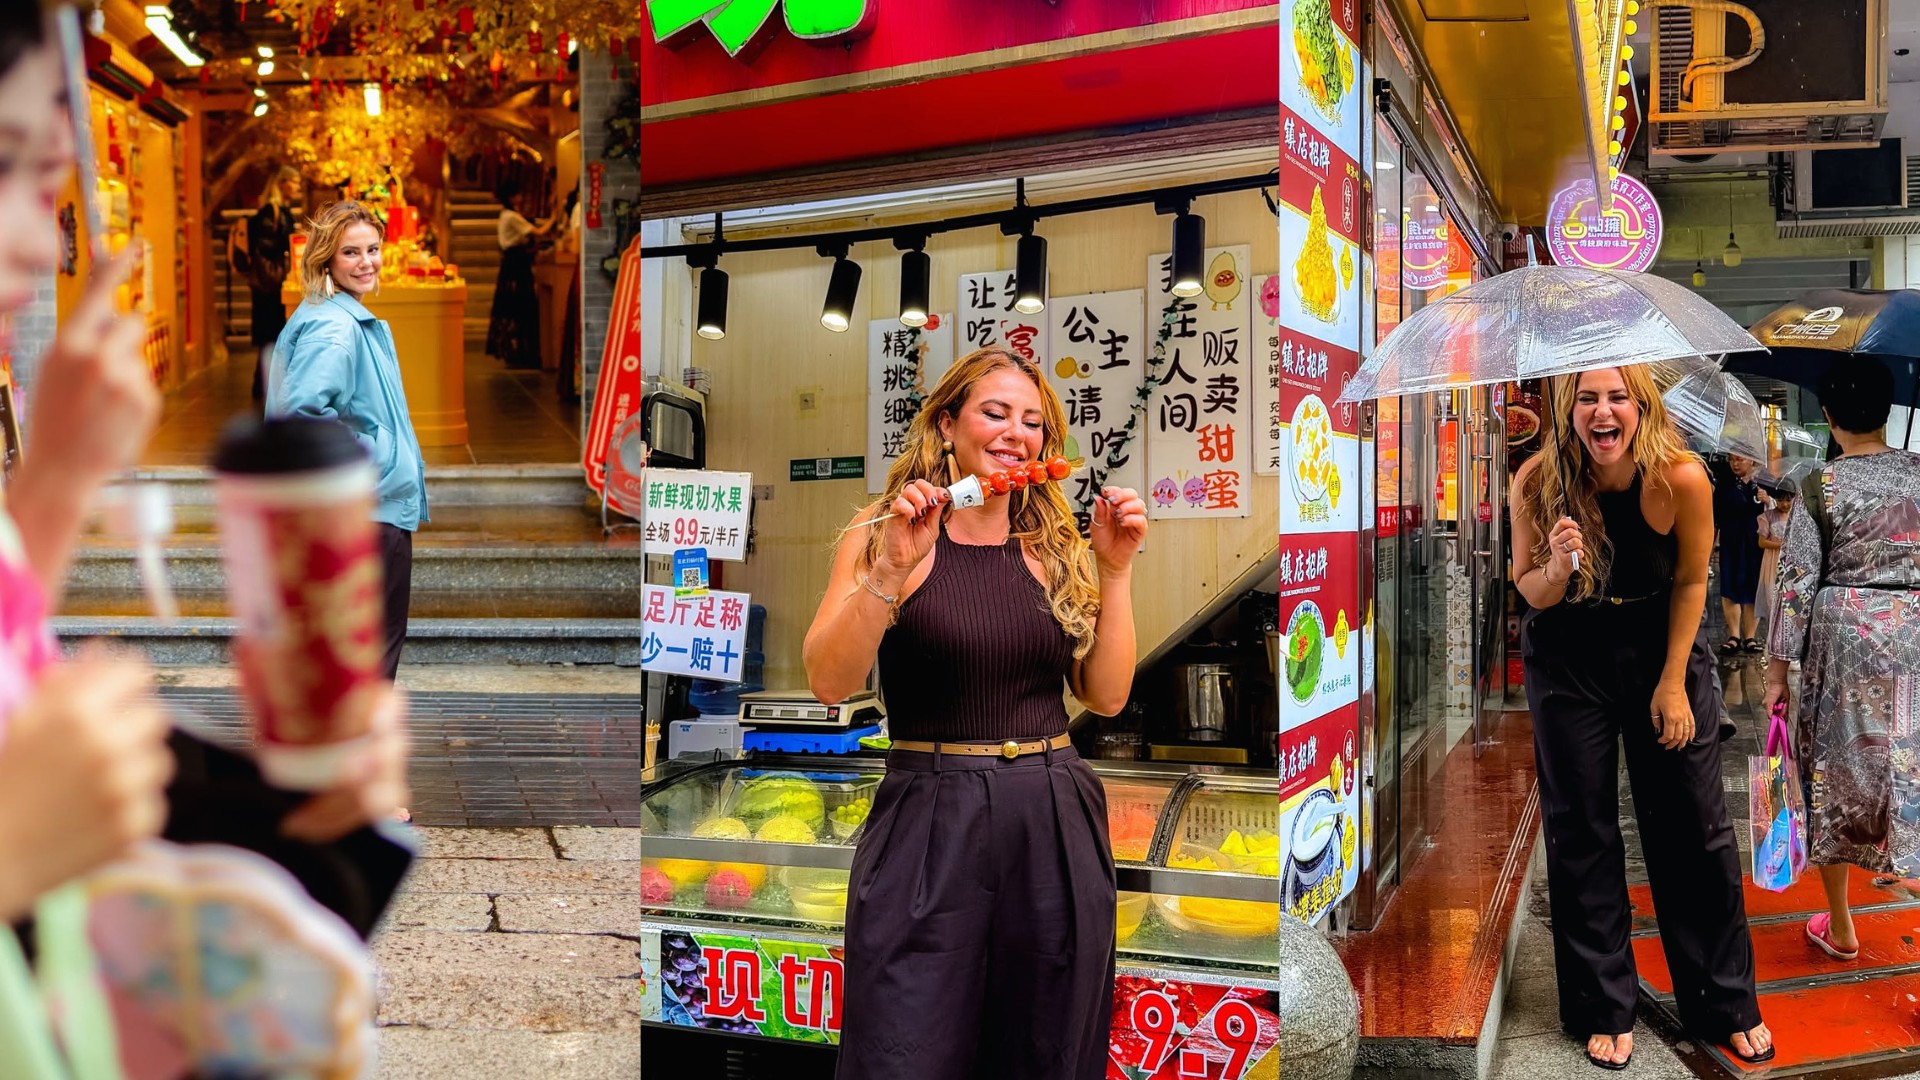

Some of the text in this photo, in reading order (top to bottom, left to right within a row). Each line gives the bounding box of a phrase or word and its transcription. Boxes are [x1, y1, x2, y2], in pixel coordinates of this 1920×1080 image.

[1644, 213, 1656, 243] Studio
[648, 481, 742, 513] 新鲜现切水果
[641, 631, 739, 674] 少一赔十
[701, 946, 844, 1031] 现切
[1131, 989, 1261, 1080] 9.9
